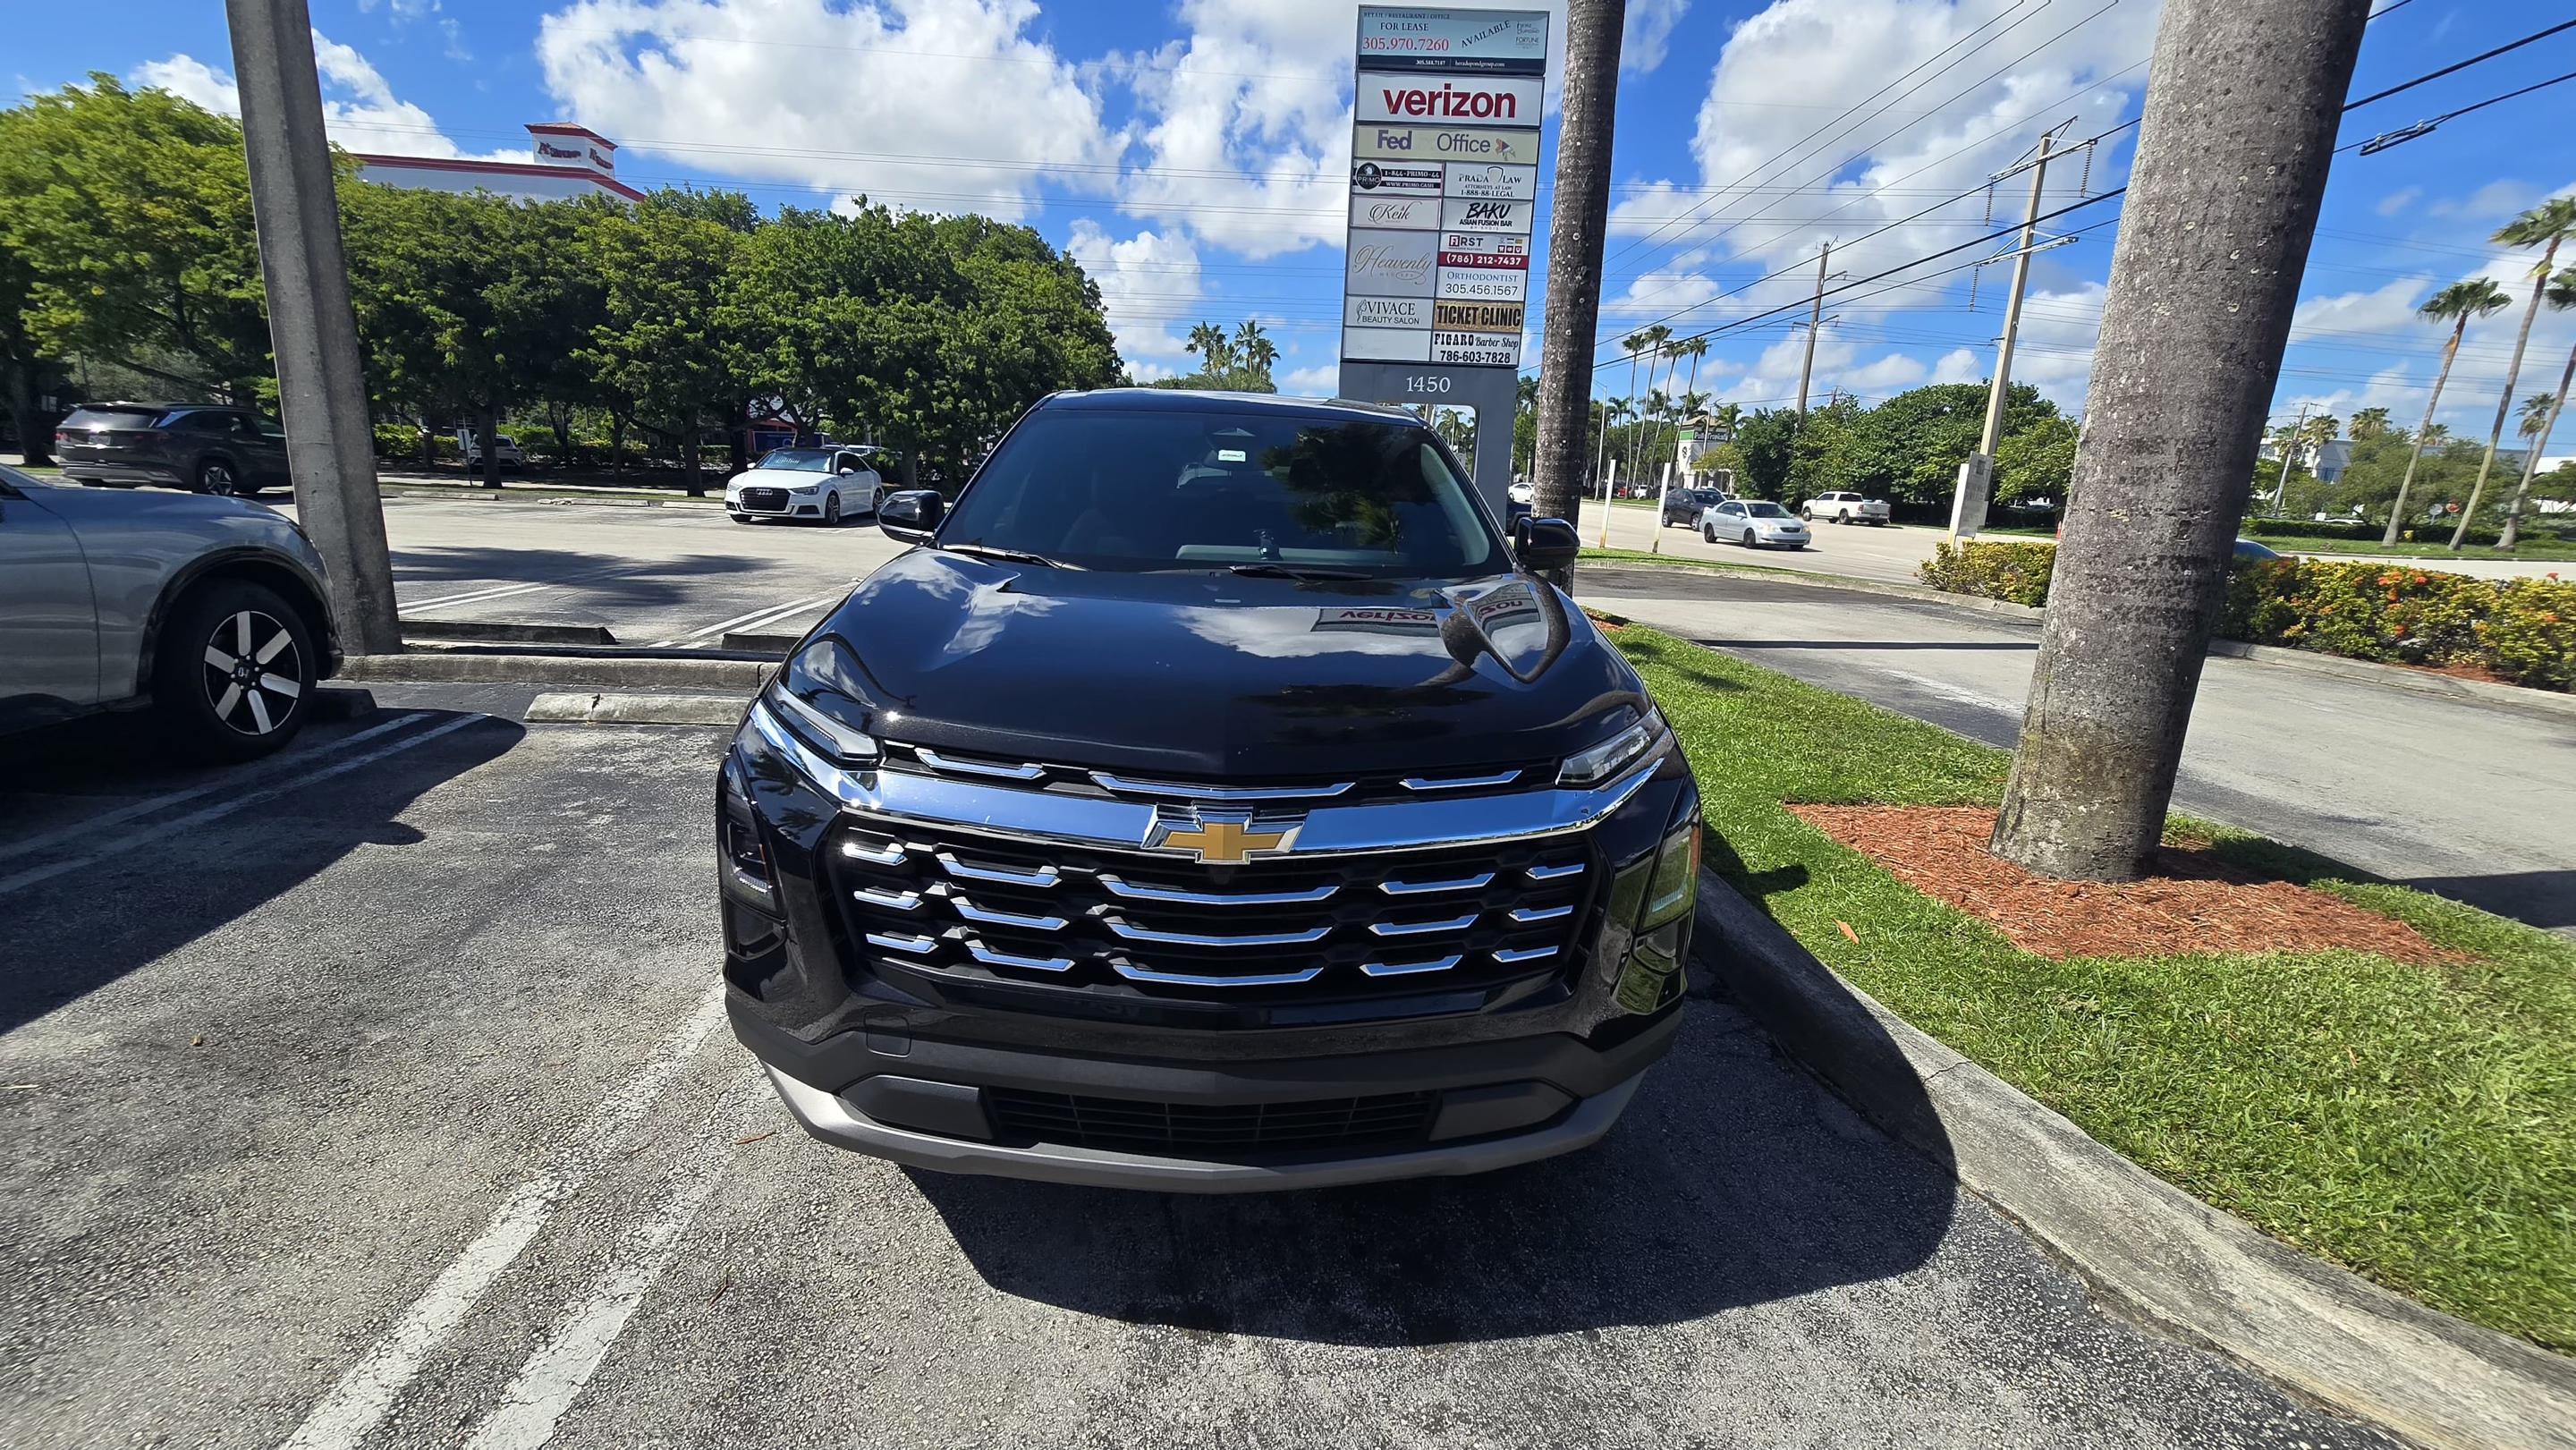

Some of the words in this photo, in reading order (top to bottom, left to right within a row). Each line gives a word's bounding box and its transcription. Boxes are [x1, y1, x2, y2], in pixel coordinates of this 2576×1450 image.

[1380, 22, 1399, 30] FOR
[1402, 22, 1428, 31] LEASE
[1461, 20, 1511, 48] AVAILABLE
[1362, 37, 1449, 51] 305.970.7260
[1383, 83, 1516, 118] verizon
[1436, 133, 1491, 153] Office
[1459, 174, 1488, 183] PRADA
[1503, 175, 1521, 184] LAW
[1466, 202, 1511, 219] BAKU
[1352, 244, 1432, 284] Heavenly
[1446, 253, 1473, 265] (786)
[1477, 256, 1521, 266] 212-7437
[1447, 271, 1518, 282] ORTHODONTIST
[1445, 284, 1518, 296] 305.456.1567
[1367, 301, 1416, 316] VIVACE
[1436, 305, 1479, 325] TICKET
[1481, 307, 1521, 326] CLINIC
[1362, 316, 1392, 324] BEAUTY
[1394, 317, 1419, 325] SALON
[1435, 333, 1474, 346] FIGARO
[1475, 336, 1500, 347] Barber
[1501, 336, 1519, 351] Shop
[1440, 350, 1511, 364] 786-603-7828
[1406, 376, 1451, 394] 1450
